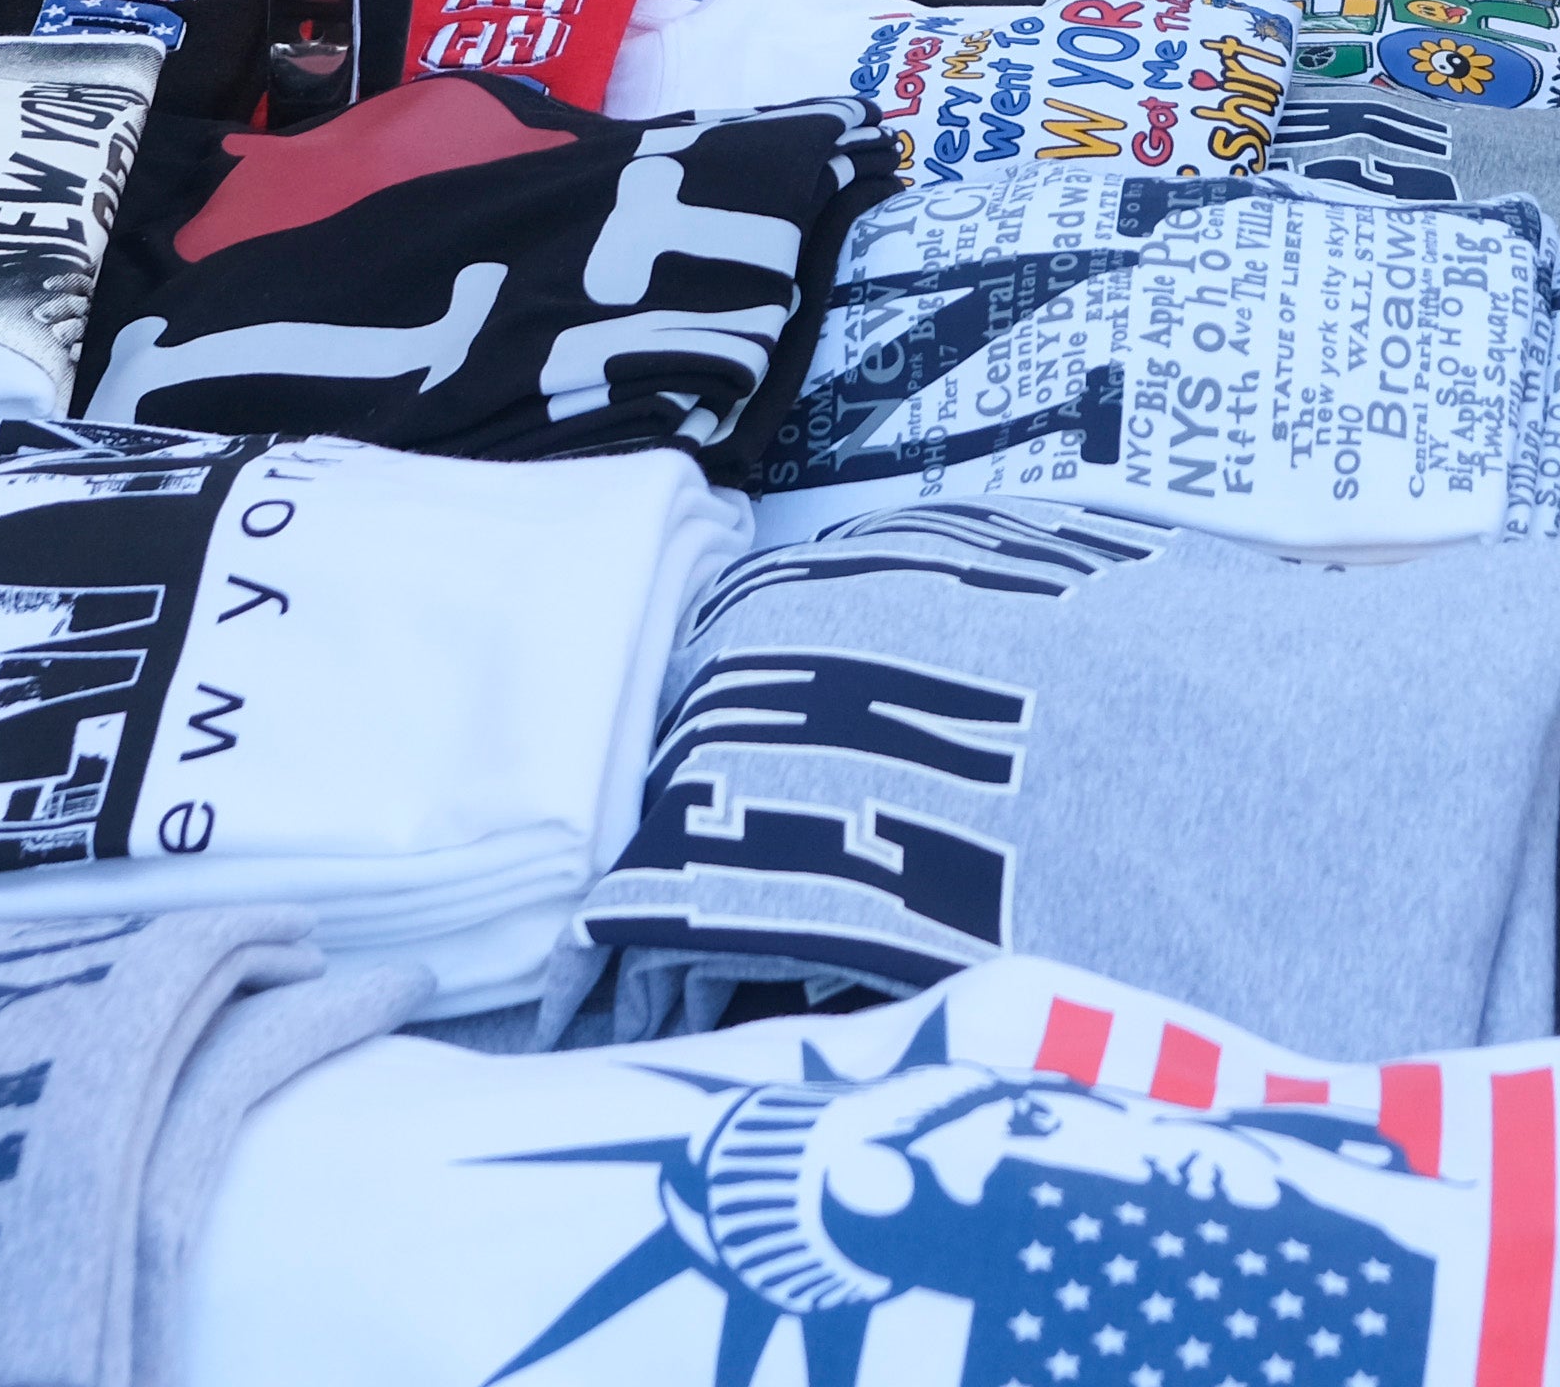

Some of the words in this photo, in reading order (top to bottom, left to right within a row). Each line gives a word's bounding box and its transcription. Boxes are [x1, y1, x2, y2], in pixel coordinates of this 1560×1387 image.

[993, 15, 1046, 50] To
[1142, 37, 1189, 91] Me
[881, 35, 944, 121] Loves
[973, 58, 1036, 164] Went
[922, 84, 983, 189] Very
[1130, 95, 1180, 169] Got
[1094, 193, 1119, 241] STATE
[1118, 179, 1147, 230] Soh
[910, 227, 950, 291] Apple
[955, 222, 979, 272] THE
[1036, 163, 1094, 325] broadwa
[1229, 258, 1269, 302] The
[907, 294, 946, 344] Big
[1085, 246, 1110, 324] EMPIRE
[1138, 273, 1186, 349] Apple
[1278, 291, 1298, 324] OF
[1319, 268, 1348, 313] city
[1346, 268, 1375, 372] WALL
[843, 264, 868, 387] STATUE
[938, 343, 959, 375] 17
[974, 273, 1017, 418] Central
[1014, 262, 1038, 399] manhattan
[1106, 305, 1134, 355] york
[1228, 306, 1253, 357] Ave
[1316, 319, 1341, 379] york
[1366, 207, 1419, 440] Broadwa
[1428, 433, 1450, 471] NY
[1442, 231, 1504, 292] Big
[1482, 290, 1517, 388] Square
[834, 280, 910, 473] New
[905, 352, 924, 393] Park
[1057, 330, 1089, 420] Apple
[1098, 357, 1126, 407] New
[1134, 356, 1182, 415] Big
[1271, 328, 1297, 442] STATUE
[1413, 328, 1434, 394] Park
[807, 367, 837, 471] MOMA
[904, 395, 924, 460] Central
[938, 376, 959, 422] Pier
[1222, 369, 1261, 495] Fifth
[1290, 385, 1318, 470] The
[1315, 381, 1337, 448] new
[1450, 364, 1489, 444] Apple
[919, 424, 950, 499] SOHO
[1052, 428, 1088, 482] Big
[1125, 415, 1155, 488] NYC
[1332, 403, 1365, 501] SOHO
[1408, 401, 1430, 499] Central
[1447, 447, 1484, 493] Big
[157, 682, 246, 857] ew
